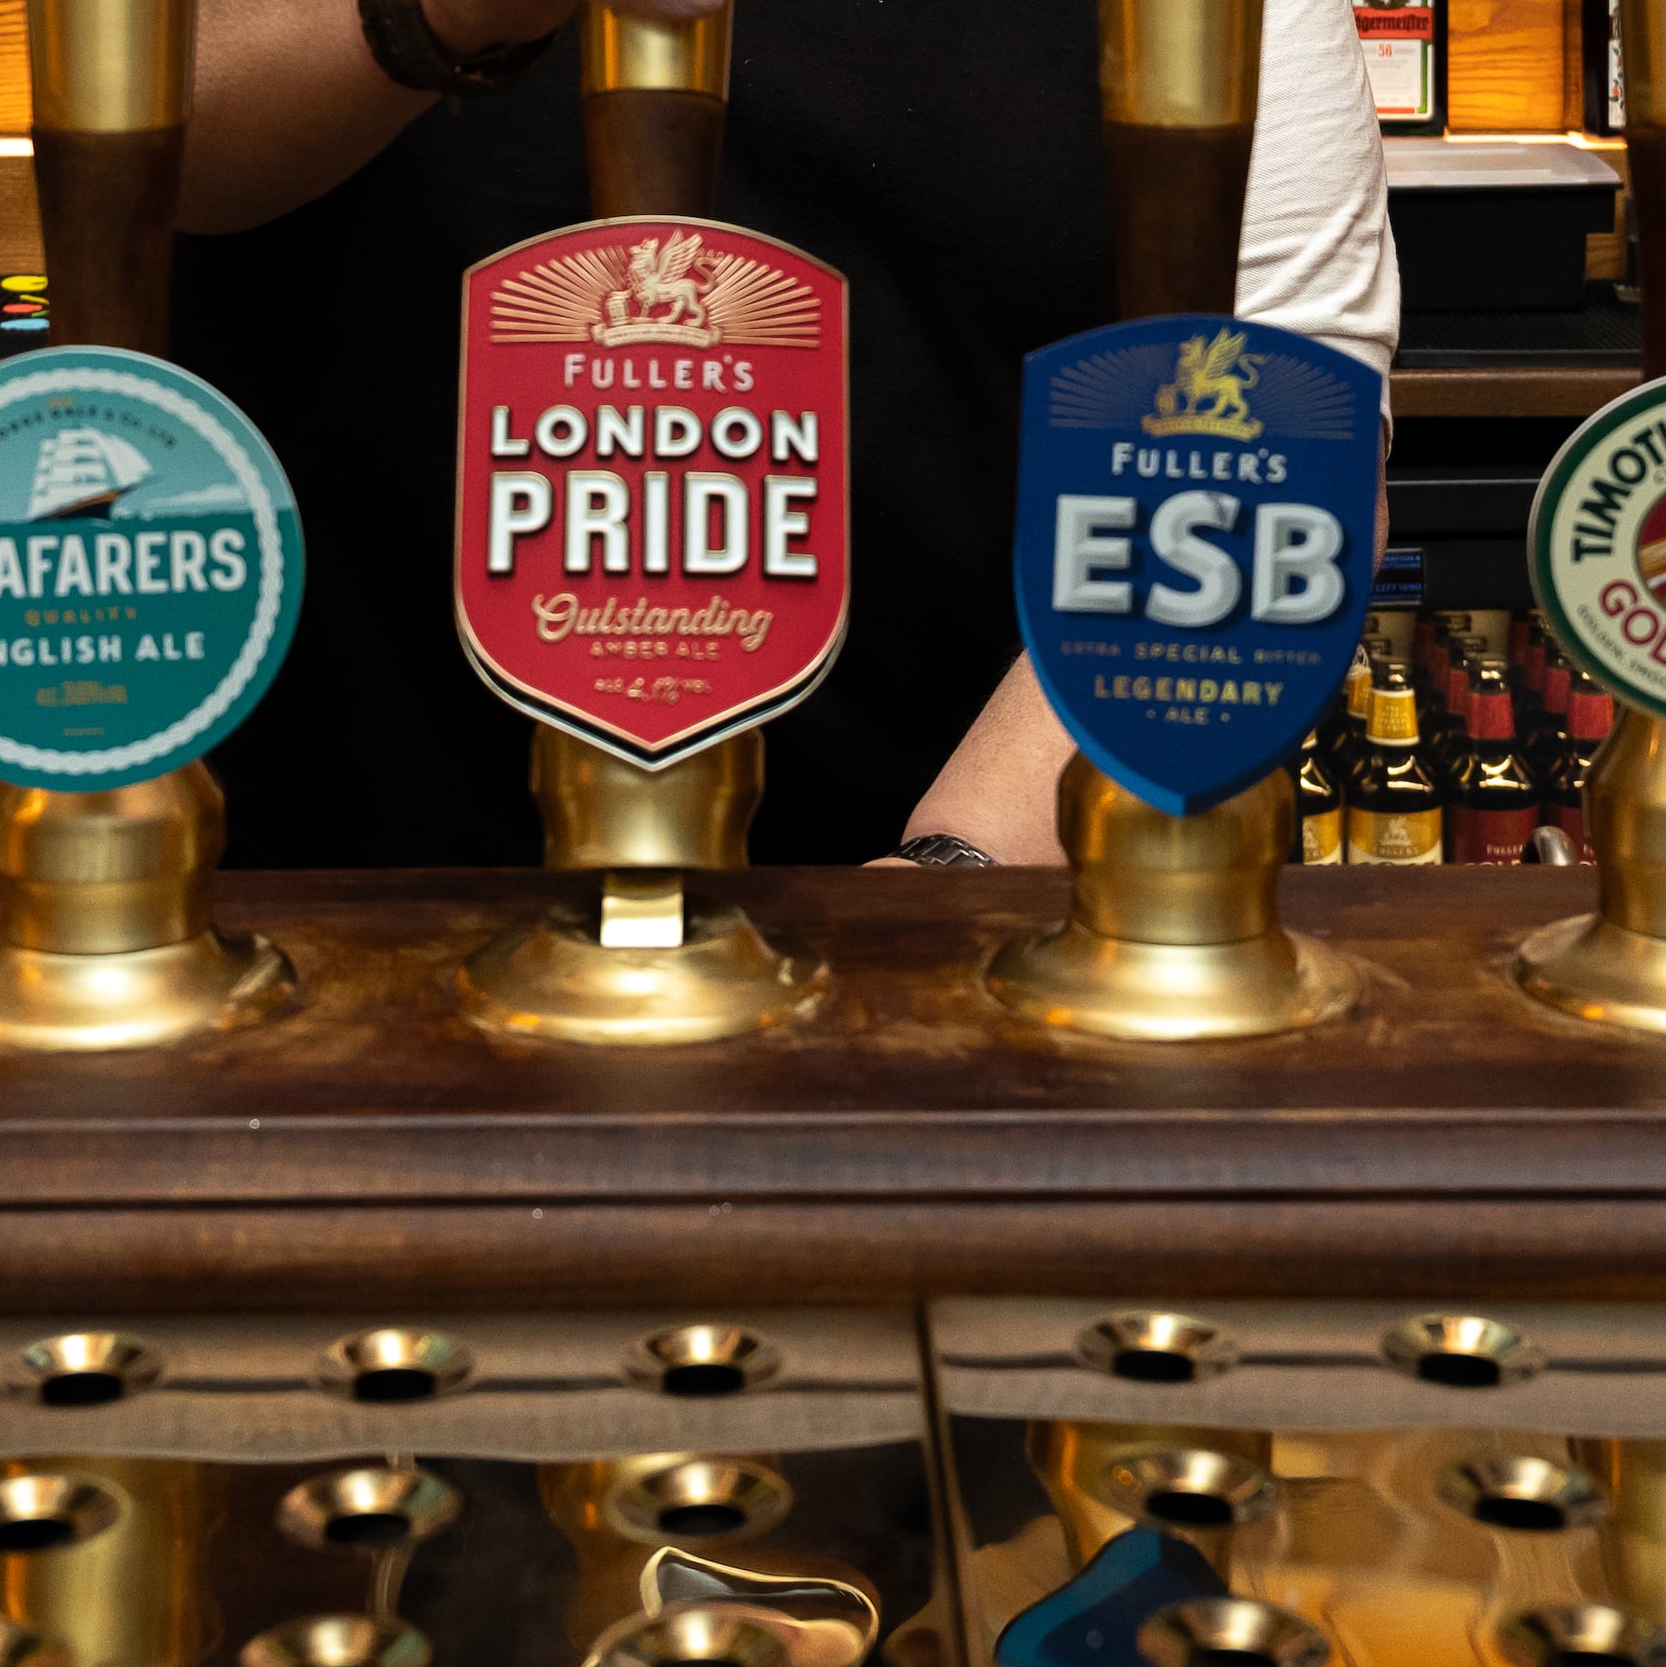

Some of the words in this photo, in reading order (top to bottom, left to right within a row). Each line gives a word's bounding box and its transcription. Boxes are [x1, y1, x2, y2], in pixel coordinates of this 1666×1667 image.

[563, 352, 755, 394] FULLER'S
[488, 403, 821, 464] LONDON
[1111, 441, 1288, 486] FULLER'S
[485, 469, 821, 578] PRIDE
[1051, 490, 1348, 629] ESB
[530, 591, 775, 653] Outstanding
[134, 630, 206, 662] ALE
[589, 640, 670, 661] AMBER
[675, 640, 721, 661] ALE
[1134, 642, 1244, 665] SPECIAL
[1093, 673, 1284, 706] LEGENDARY
[1164, 706, 1210, 725] ALE
[1486, 844, 1523, 856] FULLER
